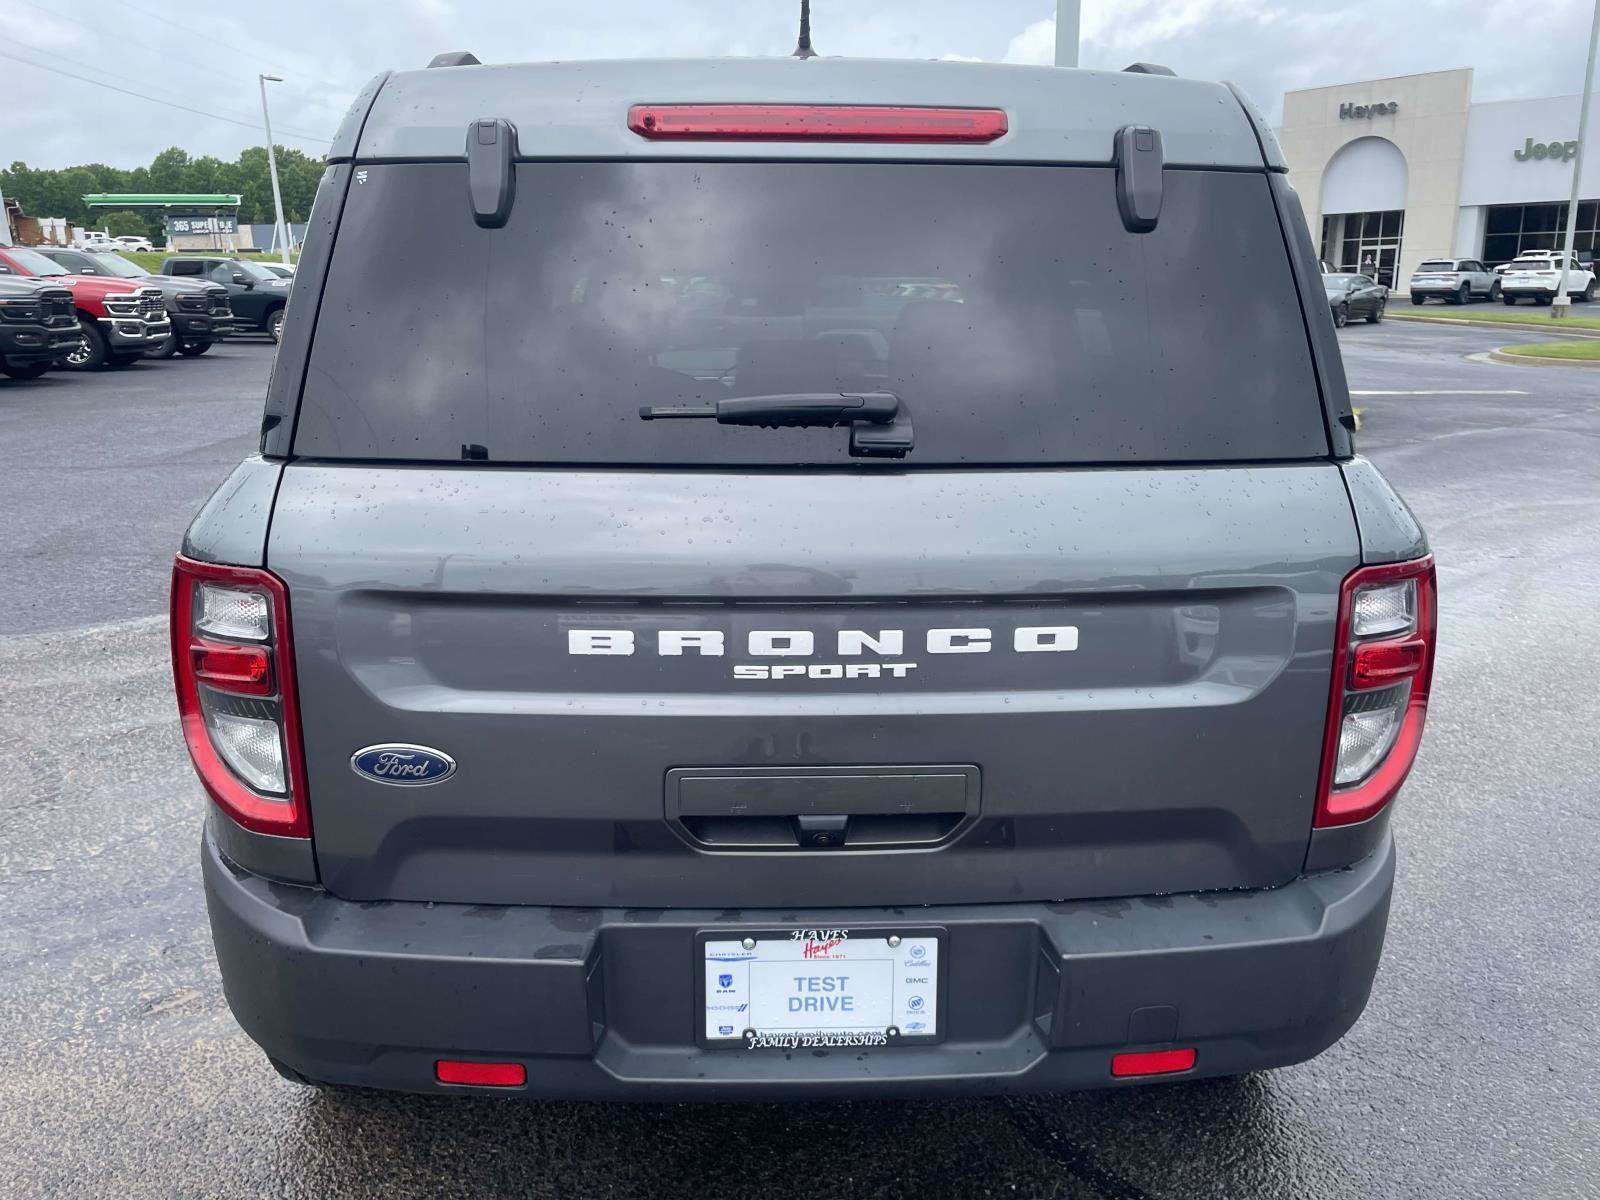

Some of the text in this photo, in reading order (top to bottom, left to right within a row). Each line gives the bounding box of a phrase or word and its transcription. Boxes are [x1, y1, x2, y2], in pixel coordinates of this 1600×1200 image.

[1340, 99, 1398, 120] Hayes
[1514, 138, 1579, 162] Jeep
[174, 220, 189, 232] 365
[568, 626, 1079, 657] BRONCO
[734, 663, 917, 680] SPORT
[374, 752, 430, 777] Ford
[790, 929, 849, 941] HAYES
[803, 938, 842, 959] Hayes
[793, 976, 850, 992] TEST
[788, 996, 854, 1012] DRIVE
[748, 1034, 888, 1050] FAMILY DEALERSHIPS
